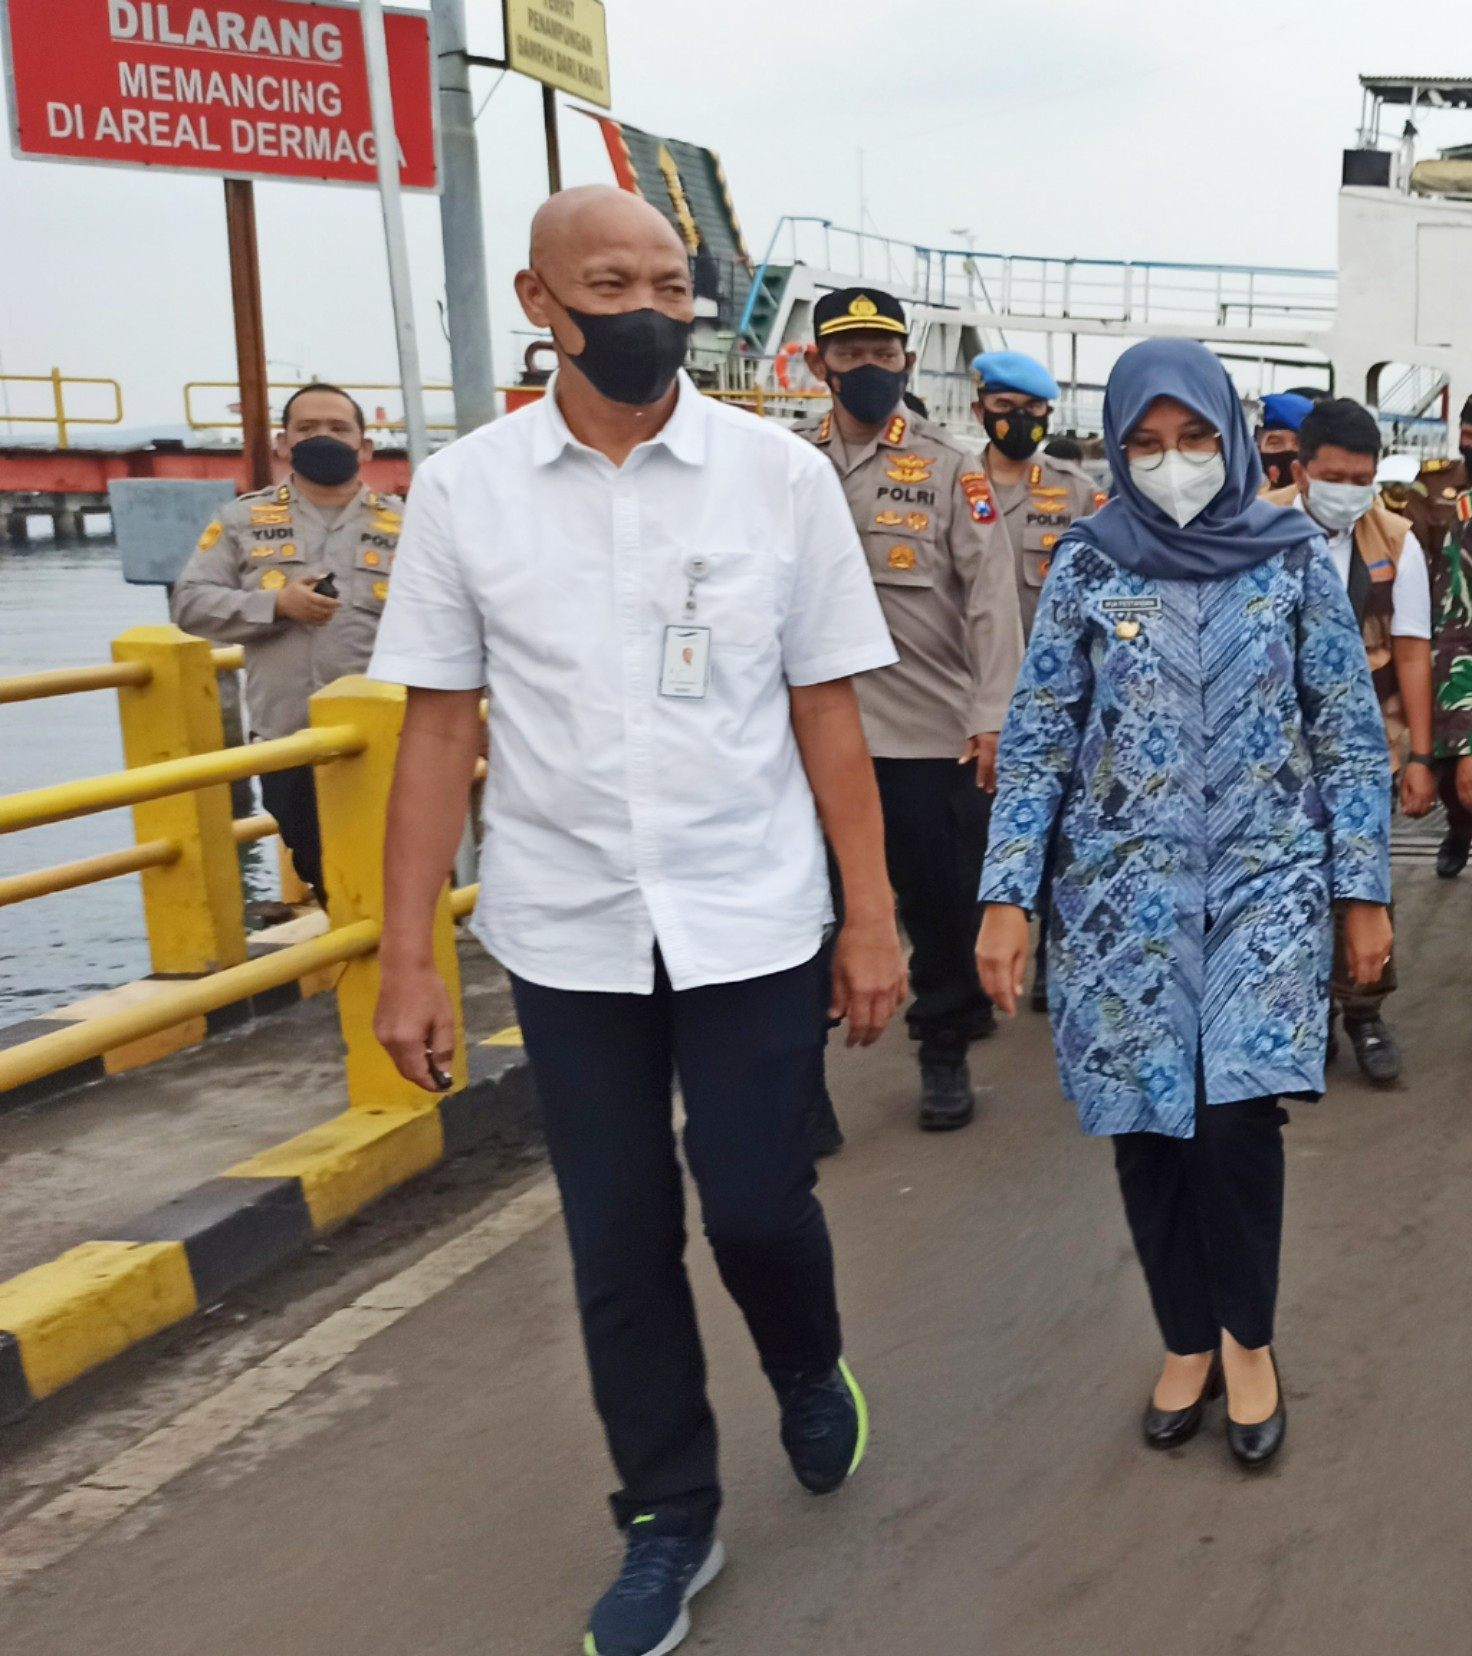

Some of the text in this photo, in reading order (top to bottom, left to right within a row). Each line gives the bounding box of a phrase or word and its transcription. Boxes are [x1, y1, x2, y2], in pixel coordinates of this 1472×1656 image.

[107, 0, 343, 62] DILARANG
[117, 61, 343, 117] MEMANCING
[46, 101, 84, 139] DI
[94, 106, 221, 151] AREAL
[876, 486, 935, 506] POLRI
[251, 527, 294, 541] YUDI
[360, 531, 399, 550] POL
